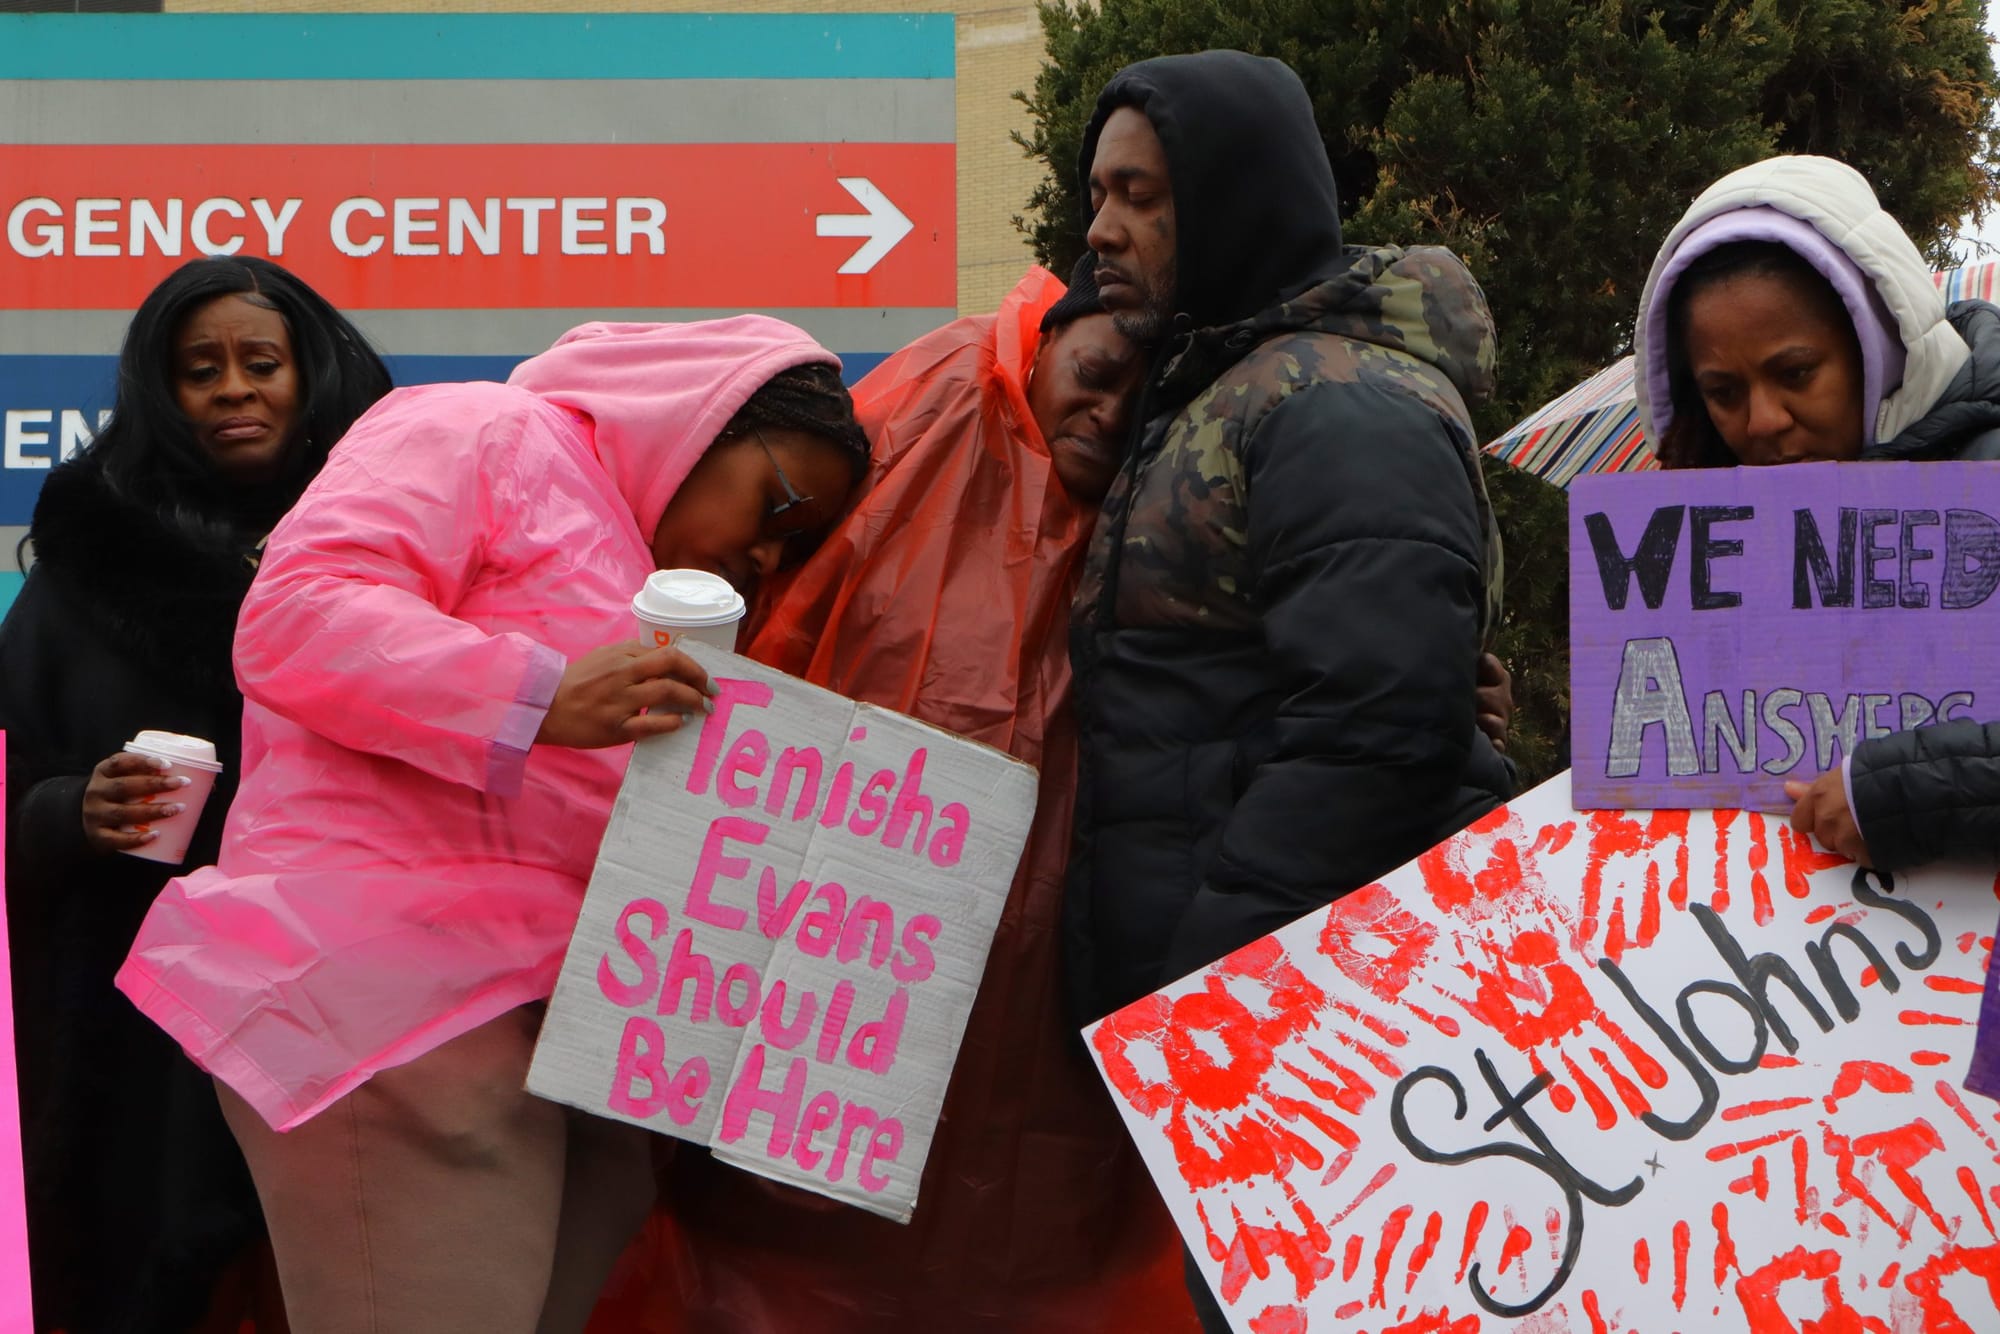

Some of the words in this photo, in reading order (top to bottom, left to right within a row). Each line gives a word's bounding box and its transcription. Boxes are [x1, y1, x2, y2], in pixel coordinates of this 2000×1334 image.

[7, 197, 303, 258] GENCY
[329, 197, 667, 257] CENTER
[1584, 504, 1754, 610] WE
[1792, 506, 2000, 610] NEED
[685, 677, 970, 868] Tenisha
[596, 897, 909, 1075] Should
[683, 815, 943, 984] Evans
[607, 1015, 711, 1127] Be
[718, 1044, 905, 1192] Here
[1391, 1048, 1645, 1319] St
[1599, 866, 1942, 1142] Johns
